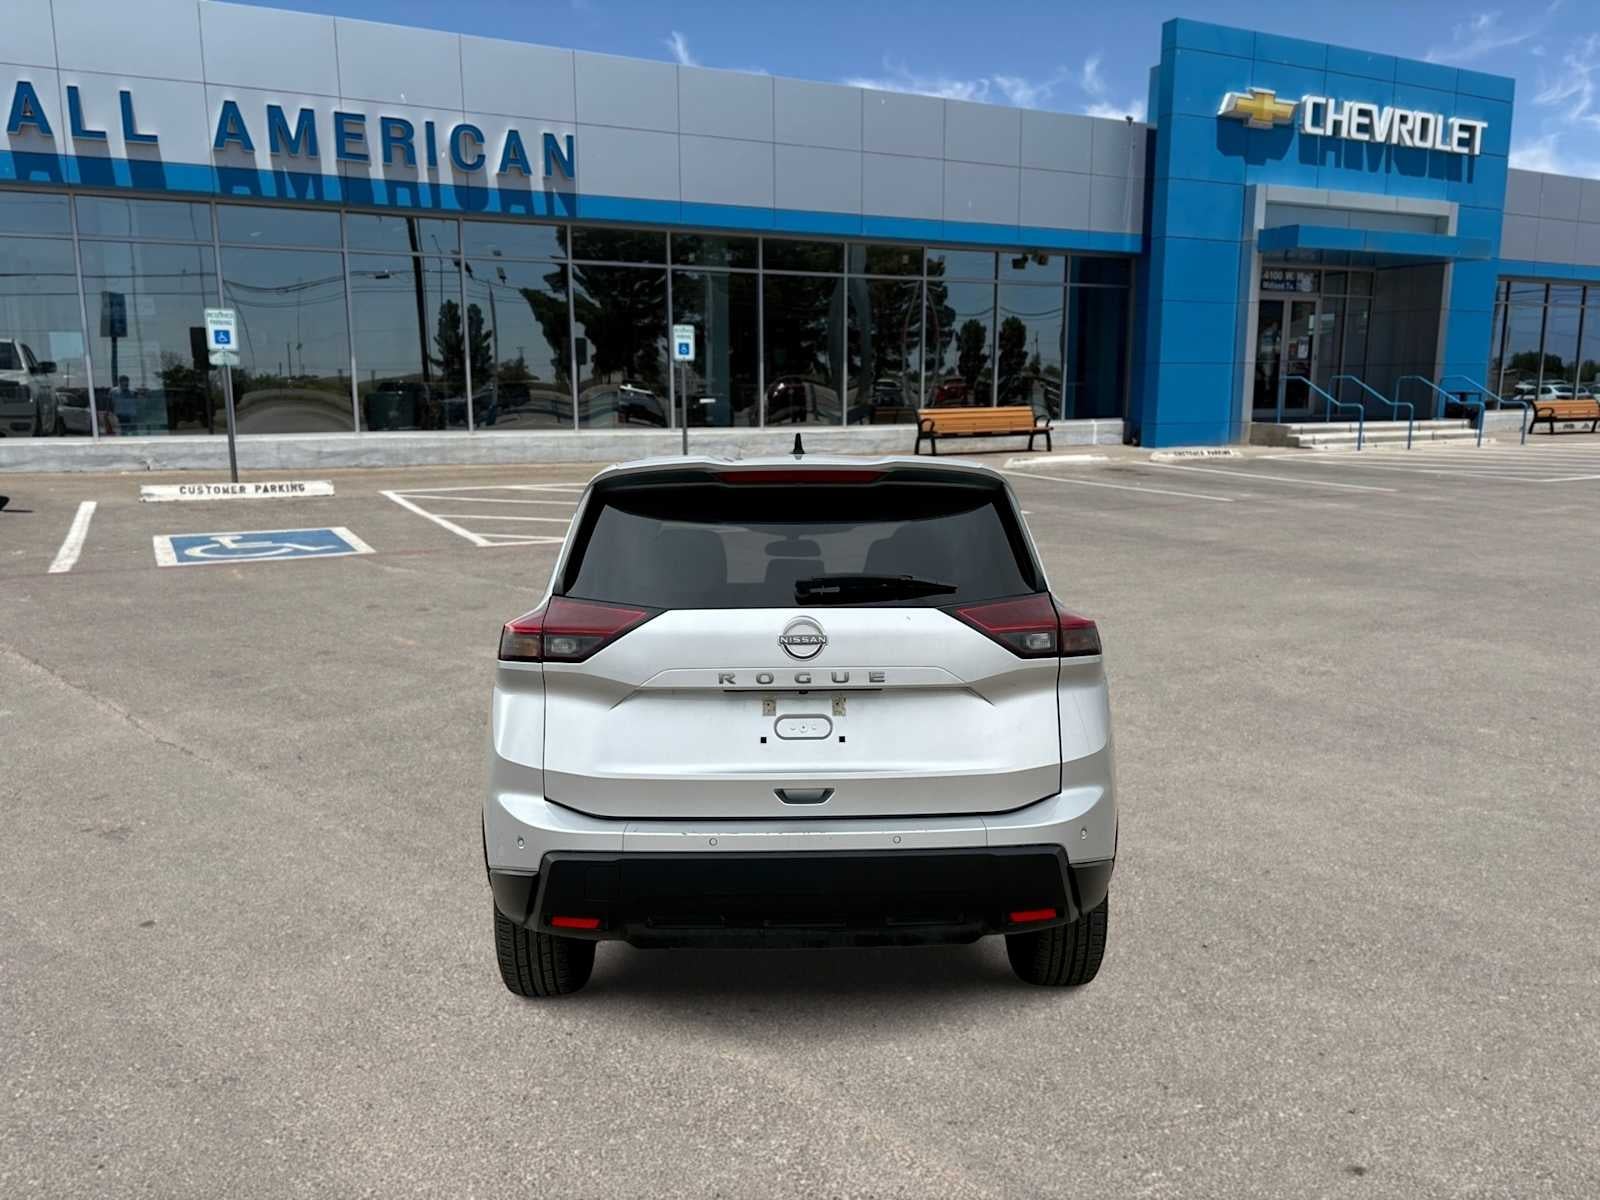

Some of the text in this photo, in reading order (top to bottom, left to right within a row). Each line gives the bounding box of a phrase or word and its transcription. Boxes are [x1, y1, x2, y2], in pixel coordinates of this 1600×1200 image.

[7, 80, 575, 178] ALL AMERICAN
[1301, 94, 1488, 156] CHEVROLET
[179, 483, 305, 495] CUSTOMER PARKING
[779, 635, 827, 644] NISSAN
[718, 671, 886, 685] ROGUE
